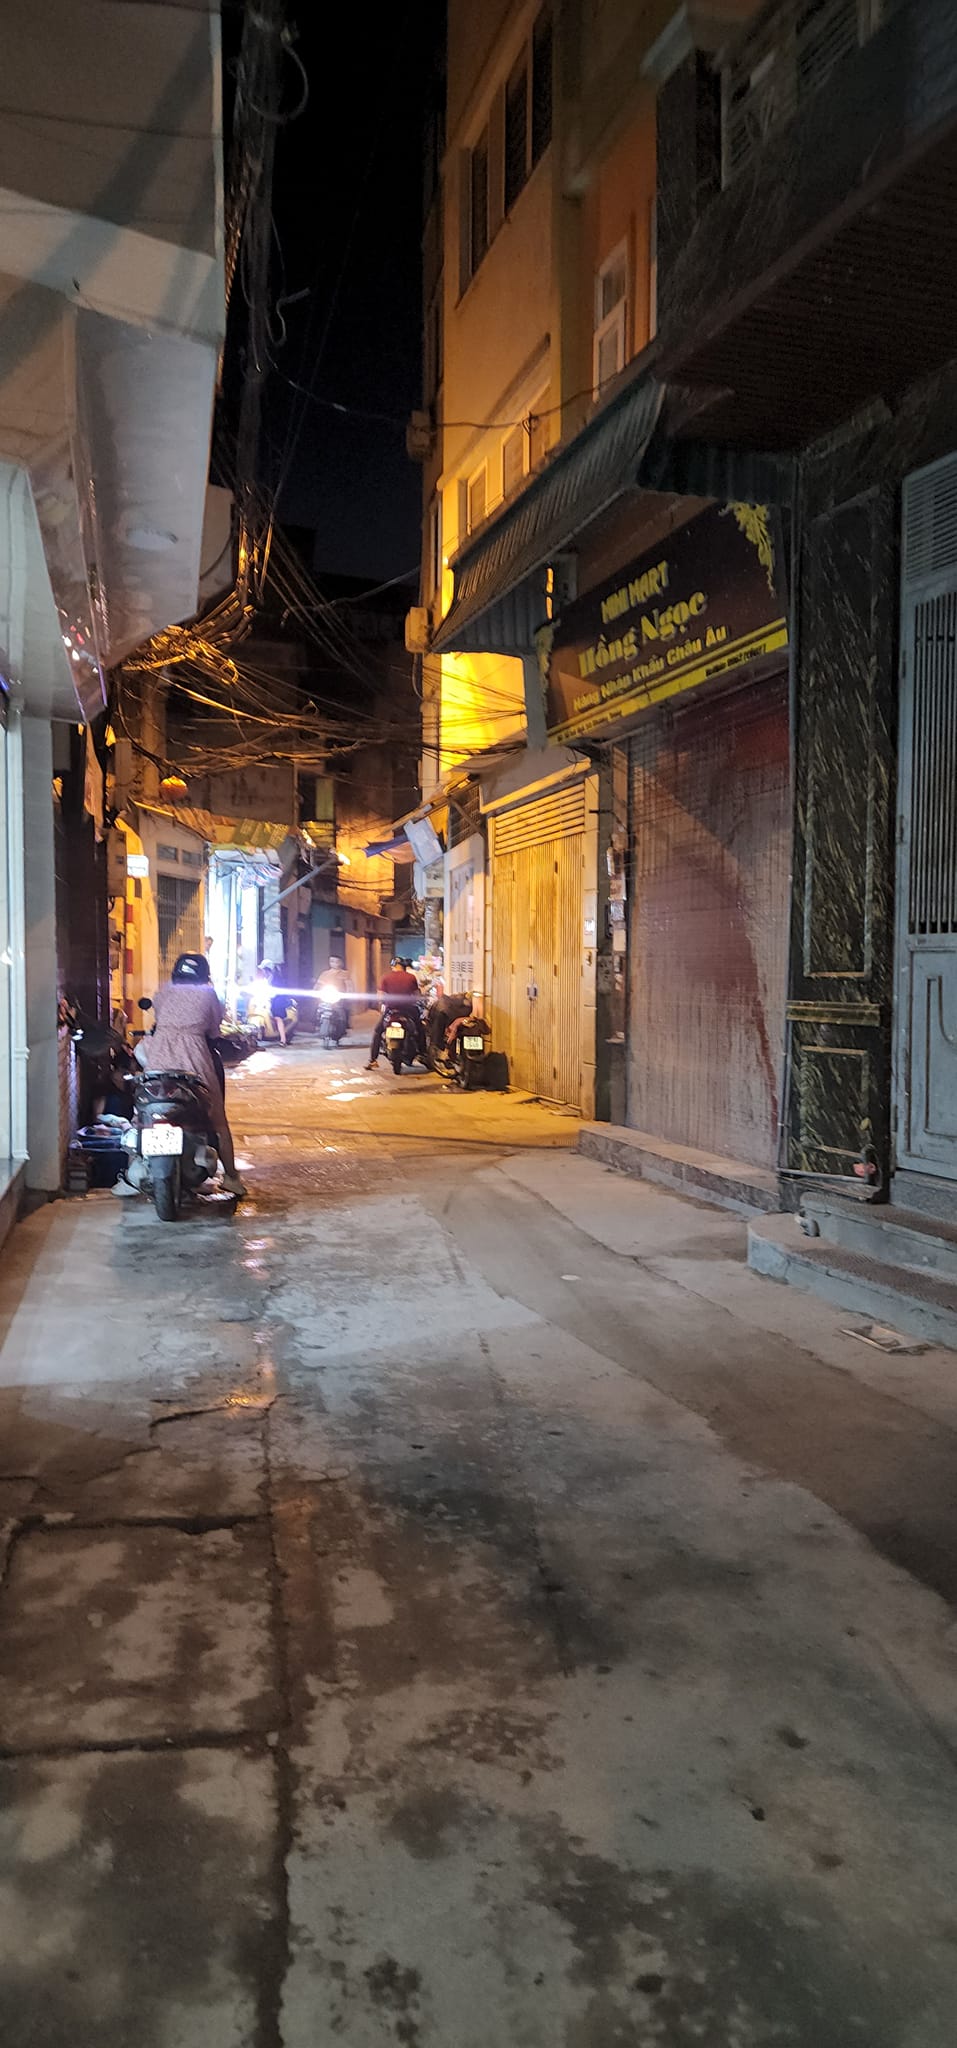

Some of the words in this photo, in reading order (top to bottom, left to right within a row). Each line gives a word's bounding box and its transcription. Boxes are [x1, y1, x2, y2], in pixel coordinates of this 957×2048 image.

[601, 587, 630, 624] MINI
[628, 560, 669, 608] MART
[578, 626, 638, 680] Hồng
[641, 591, 708, 646] Ngọc
[666, 638, 702, 666] Châu
[705, 624, 728, 648] Âu
